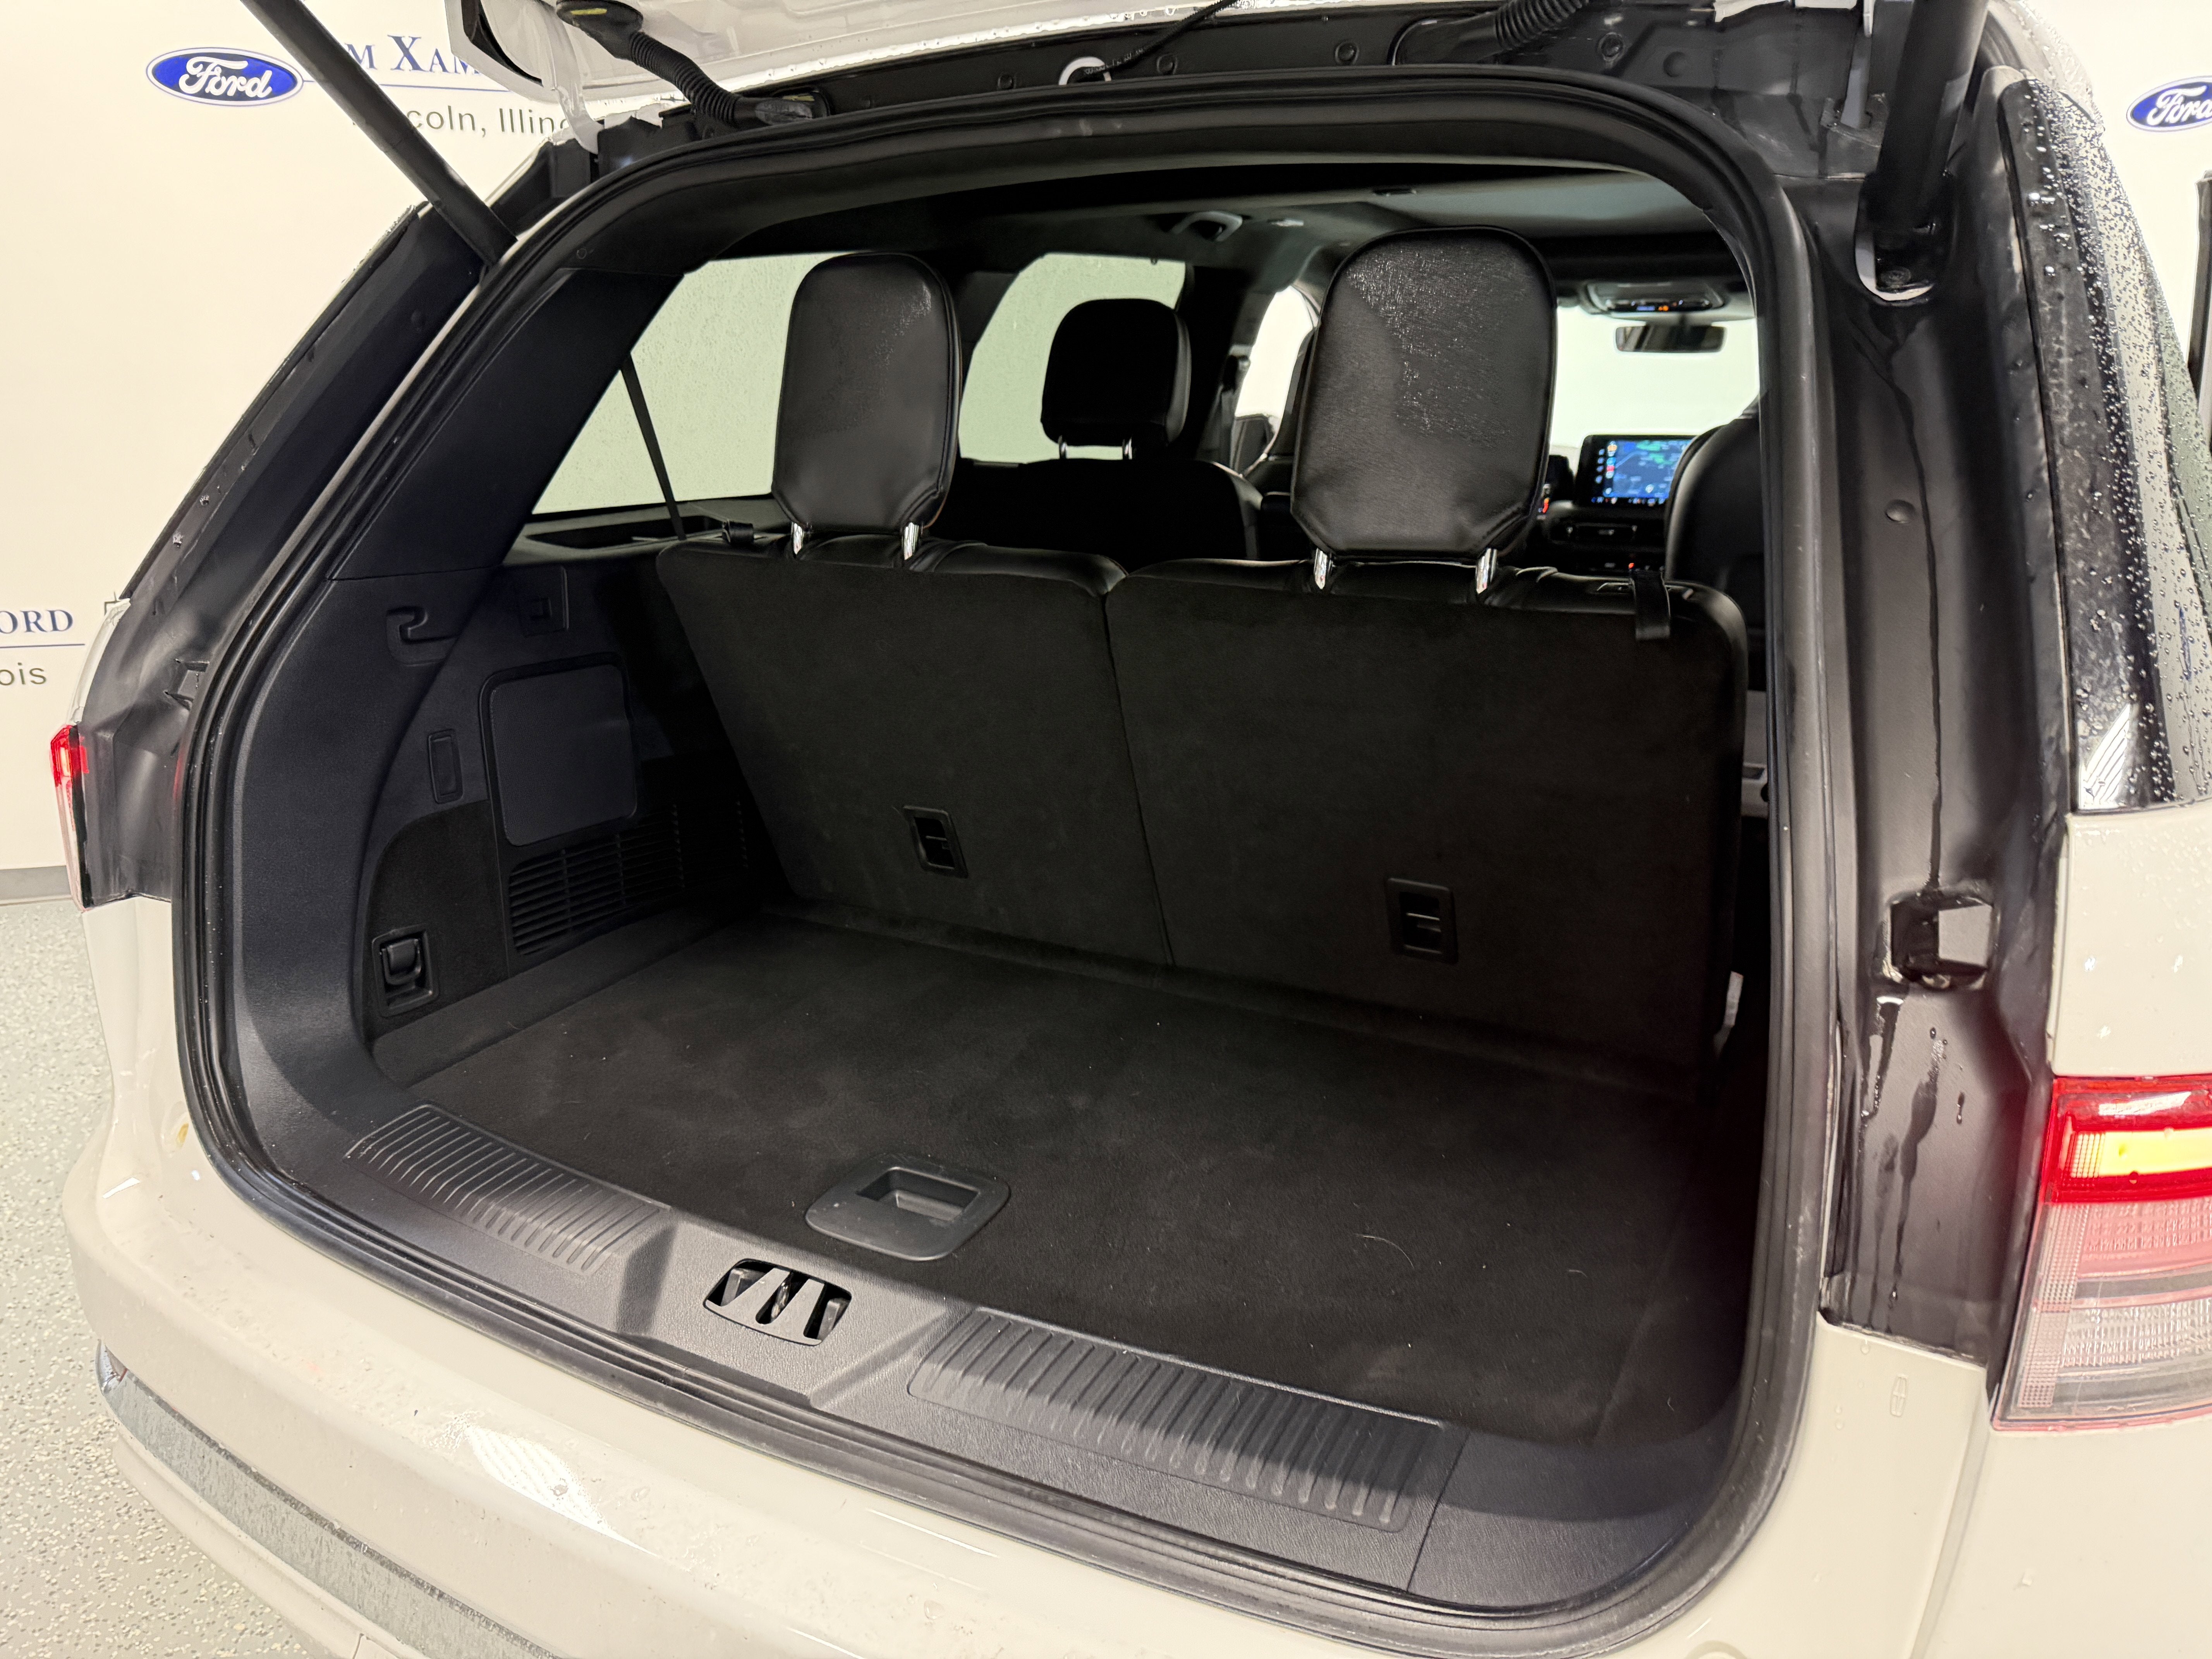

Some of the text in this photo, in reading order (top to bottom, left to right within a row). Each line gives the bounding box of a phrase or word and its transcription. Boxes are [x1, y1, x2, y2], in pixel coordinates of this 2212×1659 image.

[179, 56, 272, 98] Ford
[353, 105, 567, 137] coln, Illin
